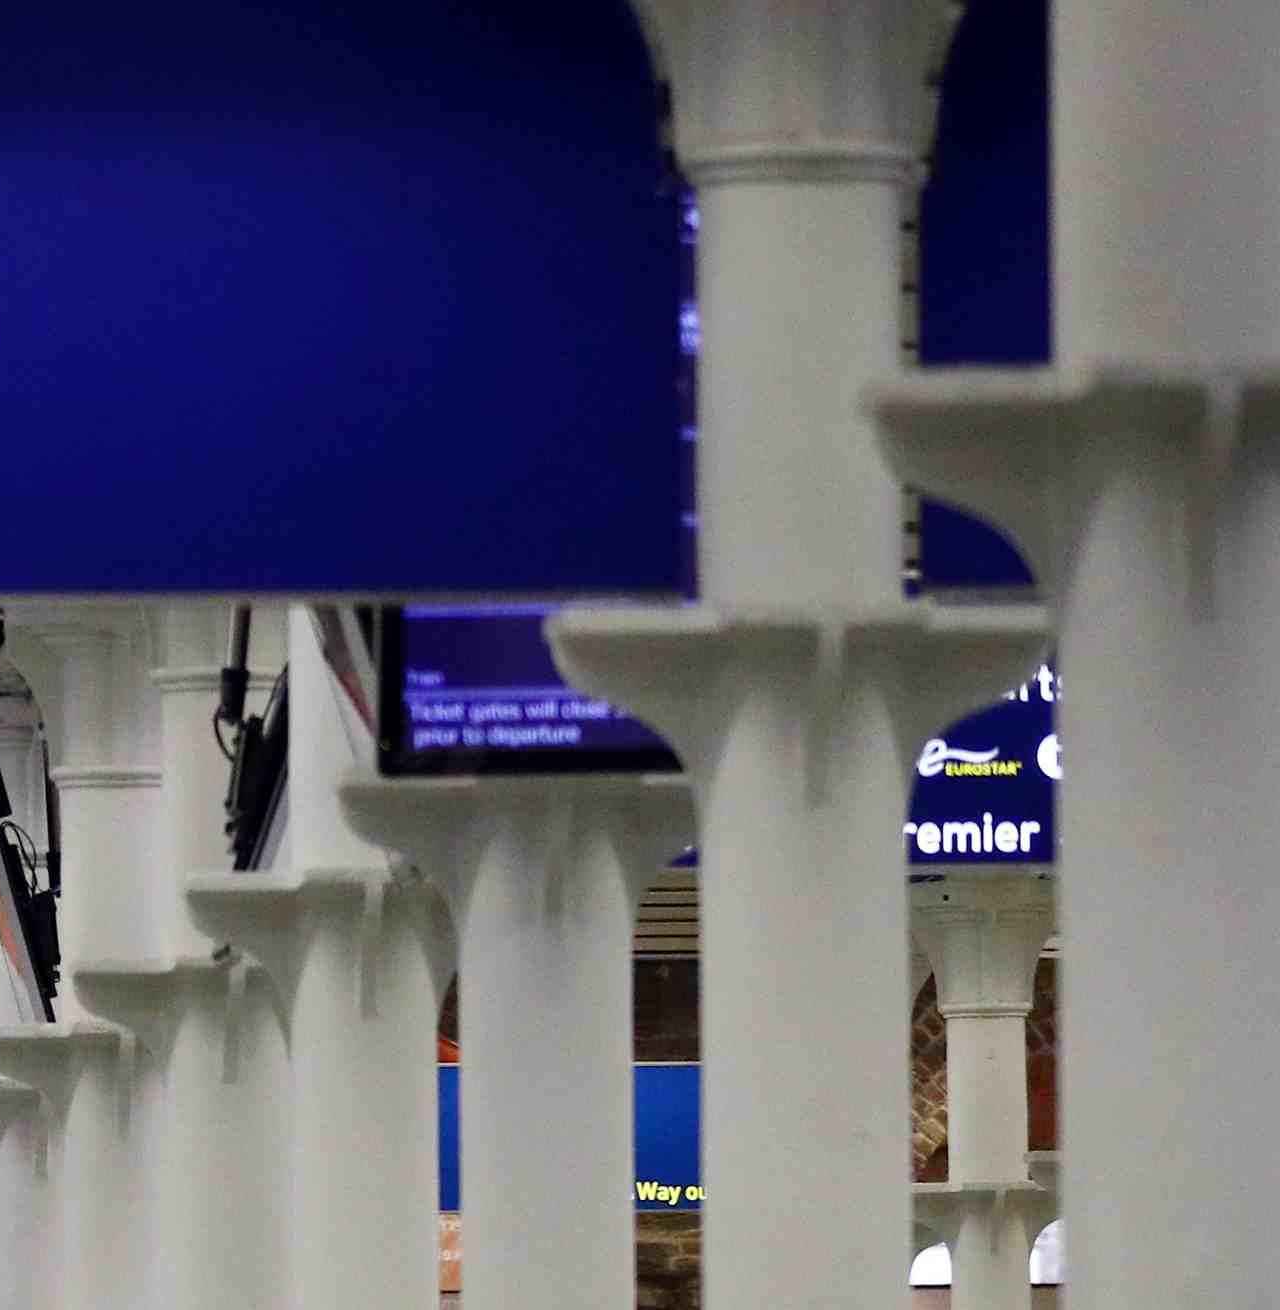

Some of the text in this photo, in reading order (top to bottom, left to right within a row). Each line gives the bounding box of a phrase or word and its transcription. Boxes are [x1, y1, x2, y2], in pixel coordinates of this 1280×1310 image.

[525, 701, 558, 719] will
[487, 725, 582, 747] departure
[903, 811, 1041, 855] remier
[635, 1181, 708, 1206] Way ou
